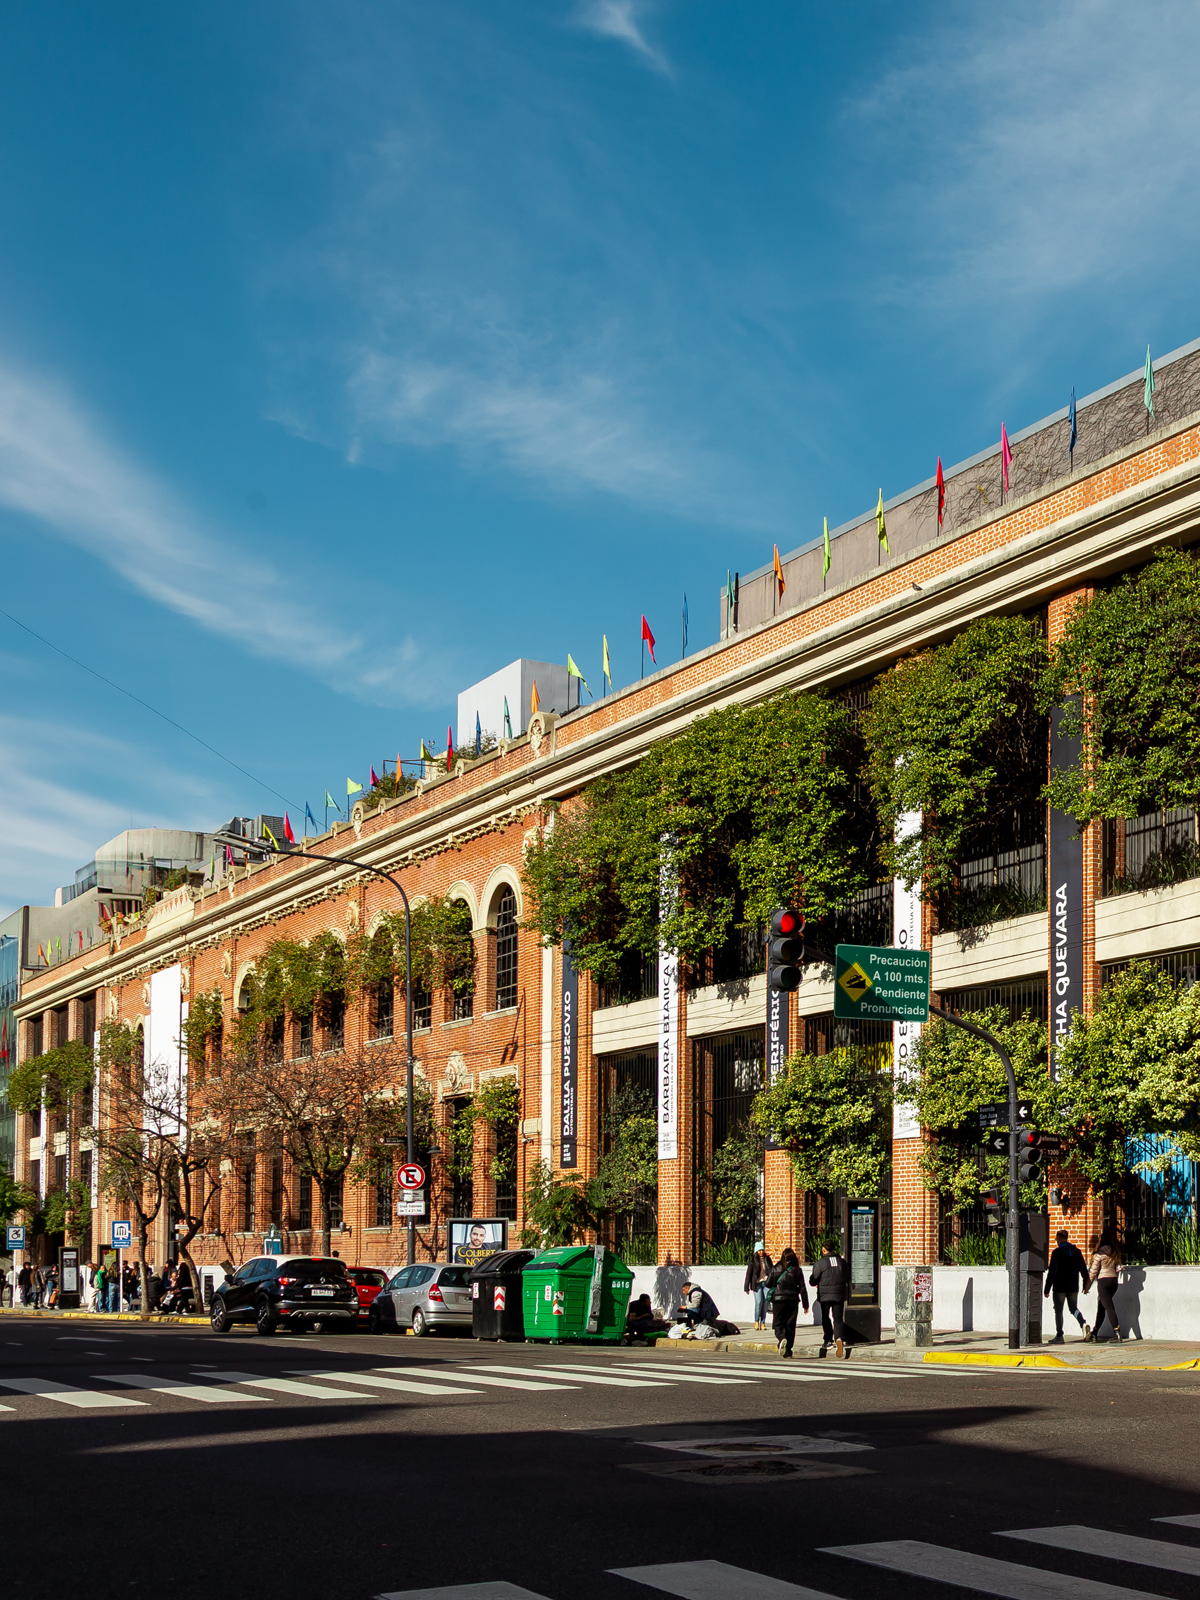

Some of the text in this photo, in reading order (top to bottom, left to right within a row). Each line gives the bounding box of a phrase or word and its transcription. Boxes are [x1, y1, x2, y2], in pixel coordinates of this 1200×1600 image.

[869, 954, 927, 968] Precaución
[872, 970, 926, 984] A 100 mts.
[662, 964, 670, 1034] BIANCA
[875, 986, 926, 1000] Pendiente
[860, 1002, 926, 1016] Pronunciada
[661, 1038, 670, 1124] BÁRBARA
[458, 1246, 496, 1257] COLBERT
